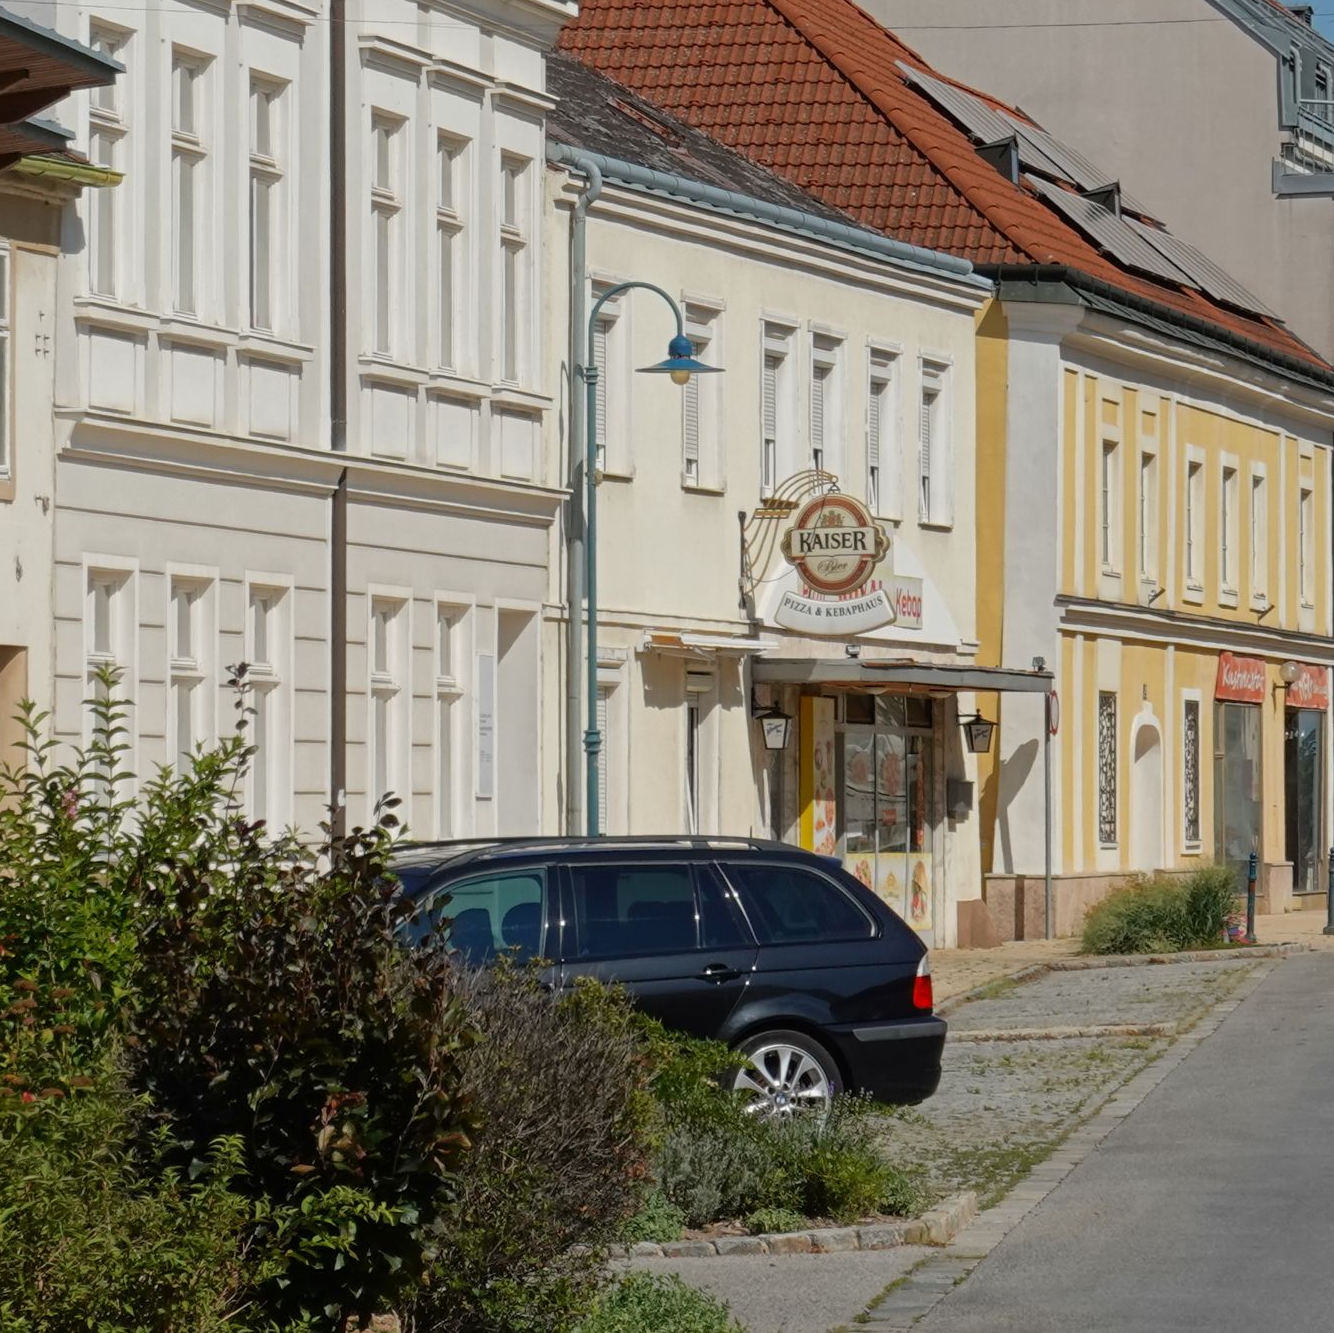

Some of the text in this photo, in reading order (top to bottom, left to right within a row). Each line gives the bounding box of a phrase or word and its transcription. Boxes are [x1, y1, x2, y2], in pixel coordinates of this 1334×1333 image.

[799, 530, 867, 553] KAISER
[783, 595, 884, 617] PIZZA & KEBAPHAUS
